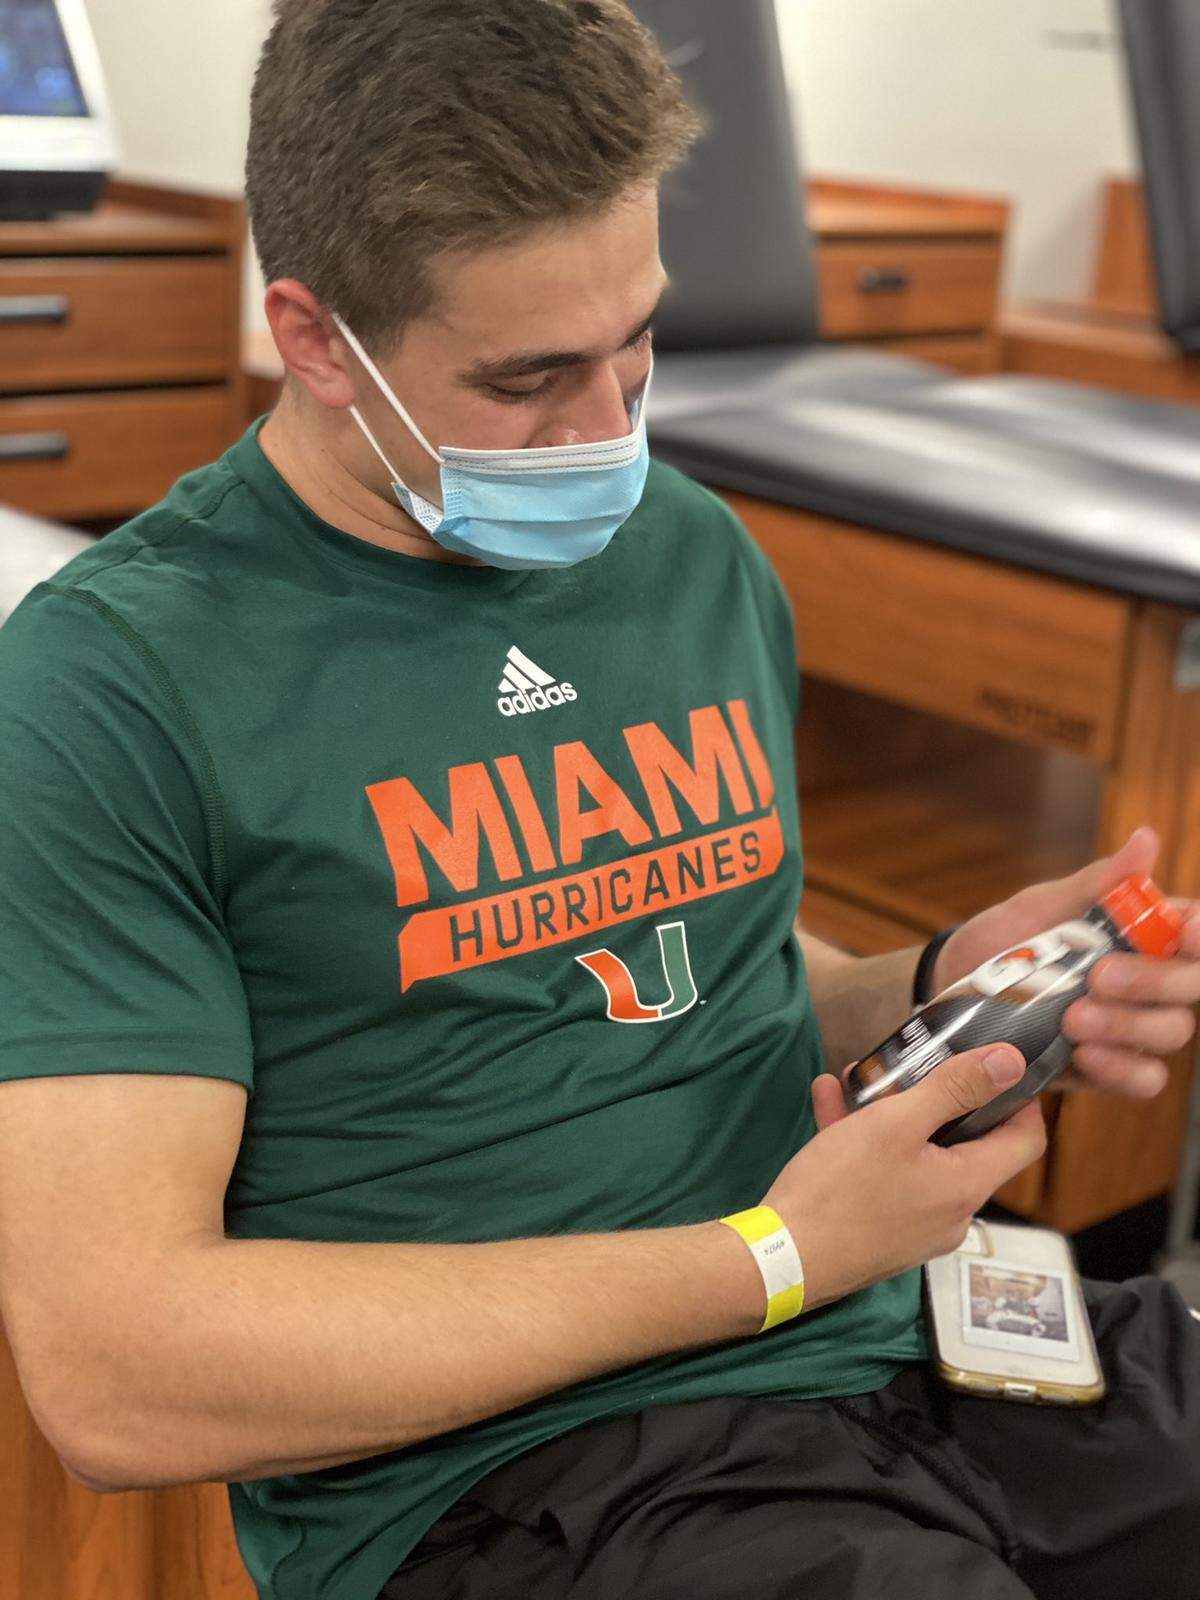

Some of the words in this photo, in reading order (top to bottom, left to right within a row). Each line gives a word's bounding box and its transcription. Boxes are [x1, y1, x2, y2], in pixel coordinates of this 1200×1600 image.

[497, 682, 577, 716] adidas
[365, 698, 775, 906] MIAMI
[449, 830, 762, 962] HURRICANES
